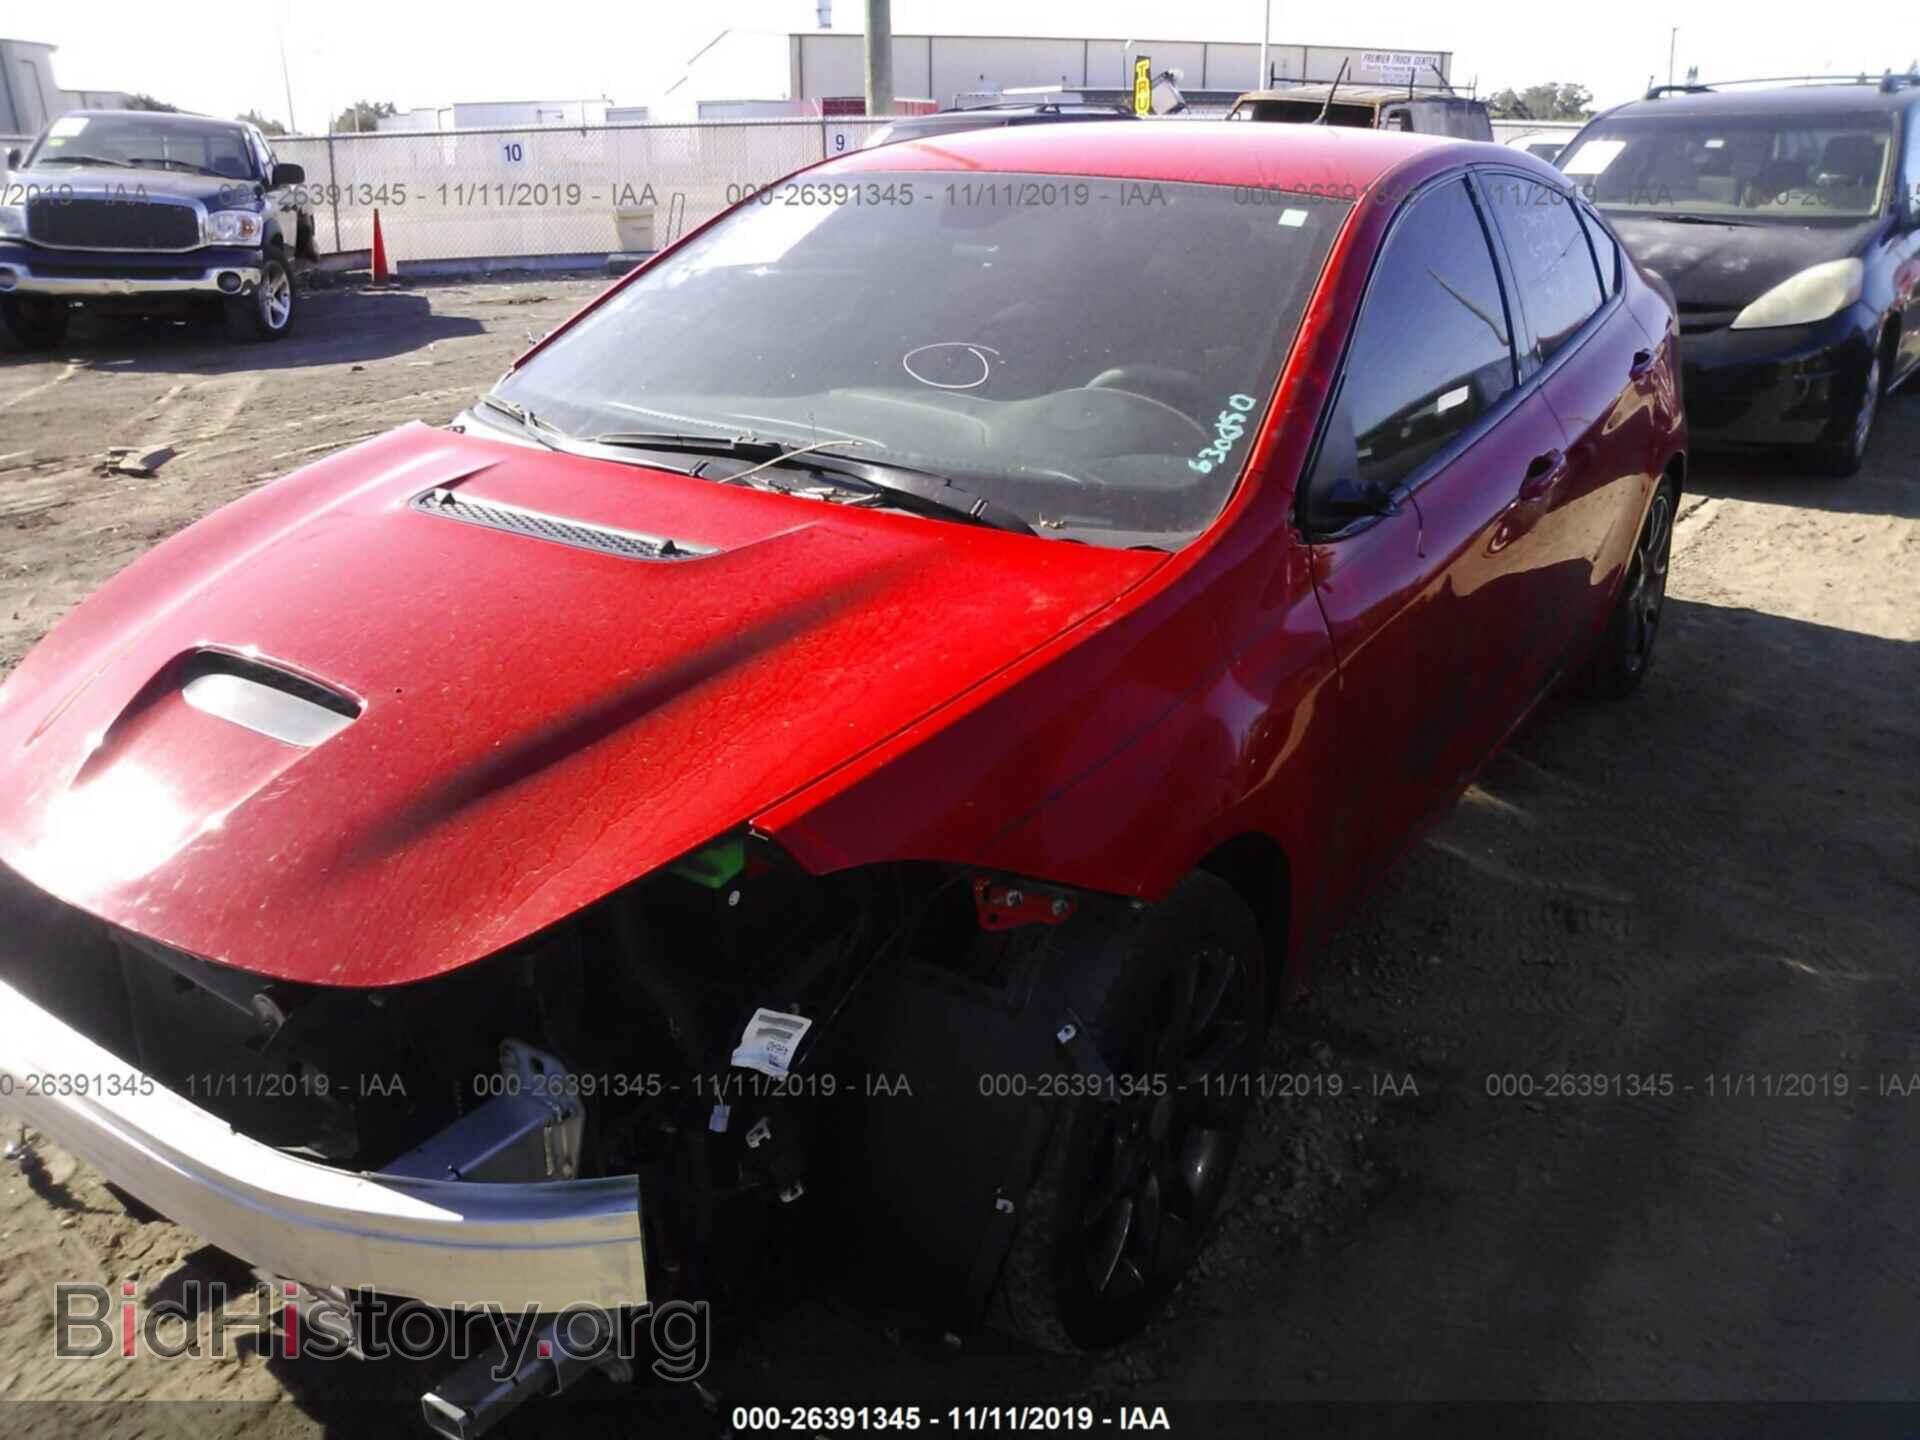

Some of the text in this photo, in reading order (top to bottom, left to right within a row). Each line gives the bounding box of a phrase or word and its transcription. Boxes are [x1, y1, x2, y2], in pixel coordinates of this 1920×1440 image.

[1363, 53, 1391, 64] PREMIER
[1392, 54, 1412, 64] TRUCK
[835, 134, 845, 151] 9
[503, 143, 522, 162] 10
